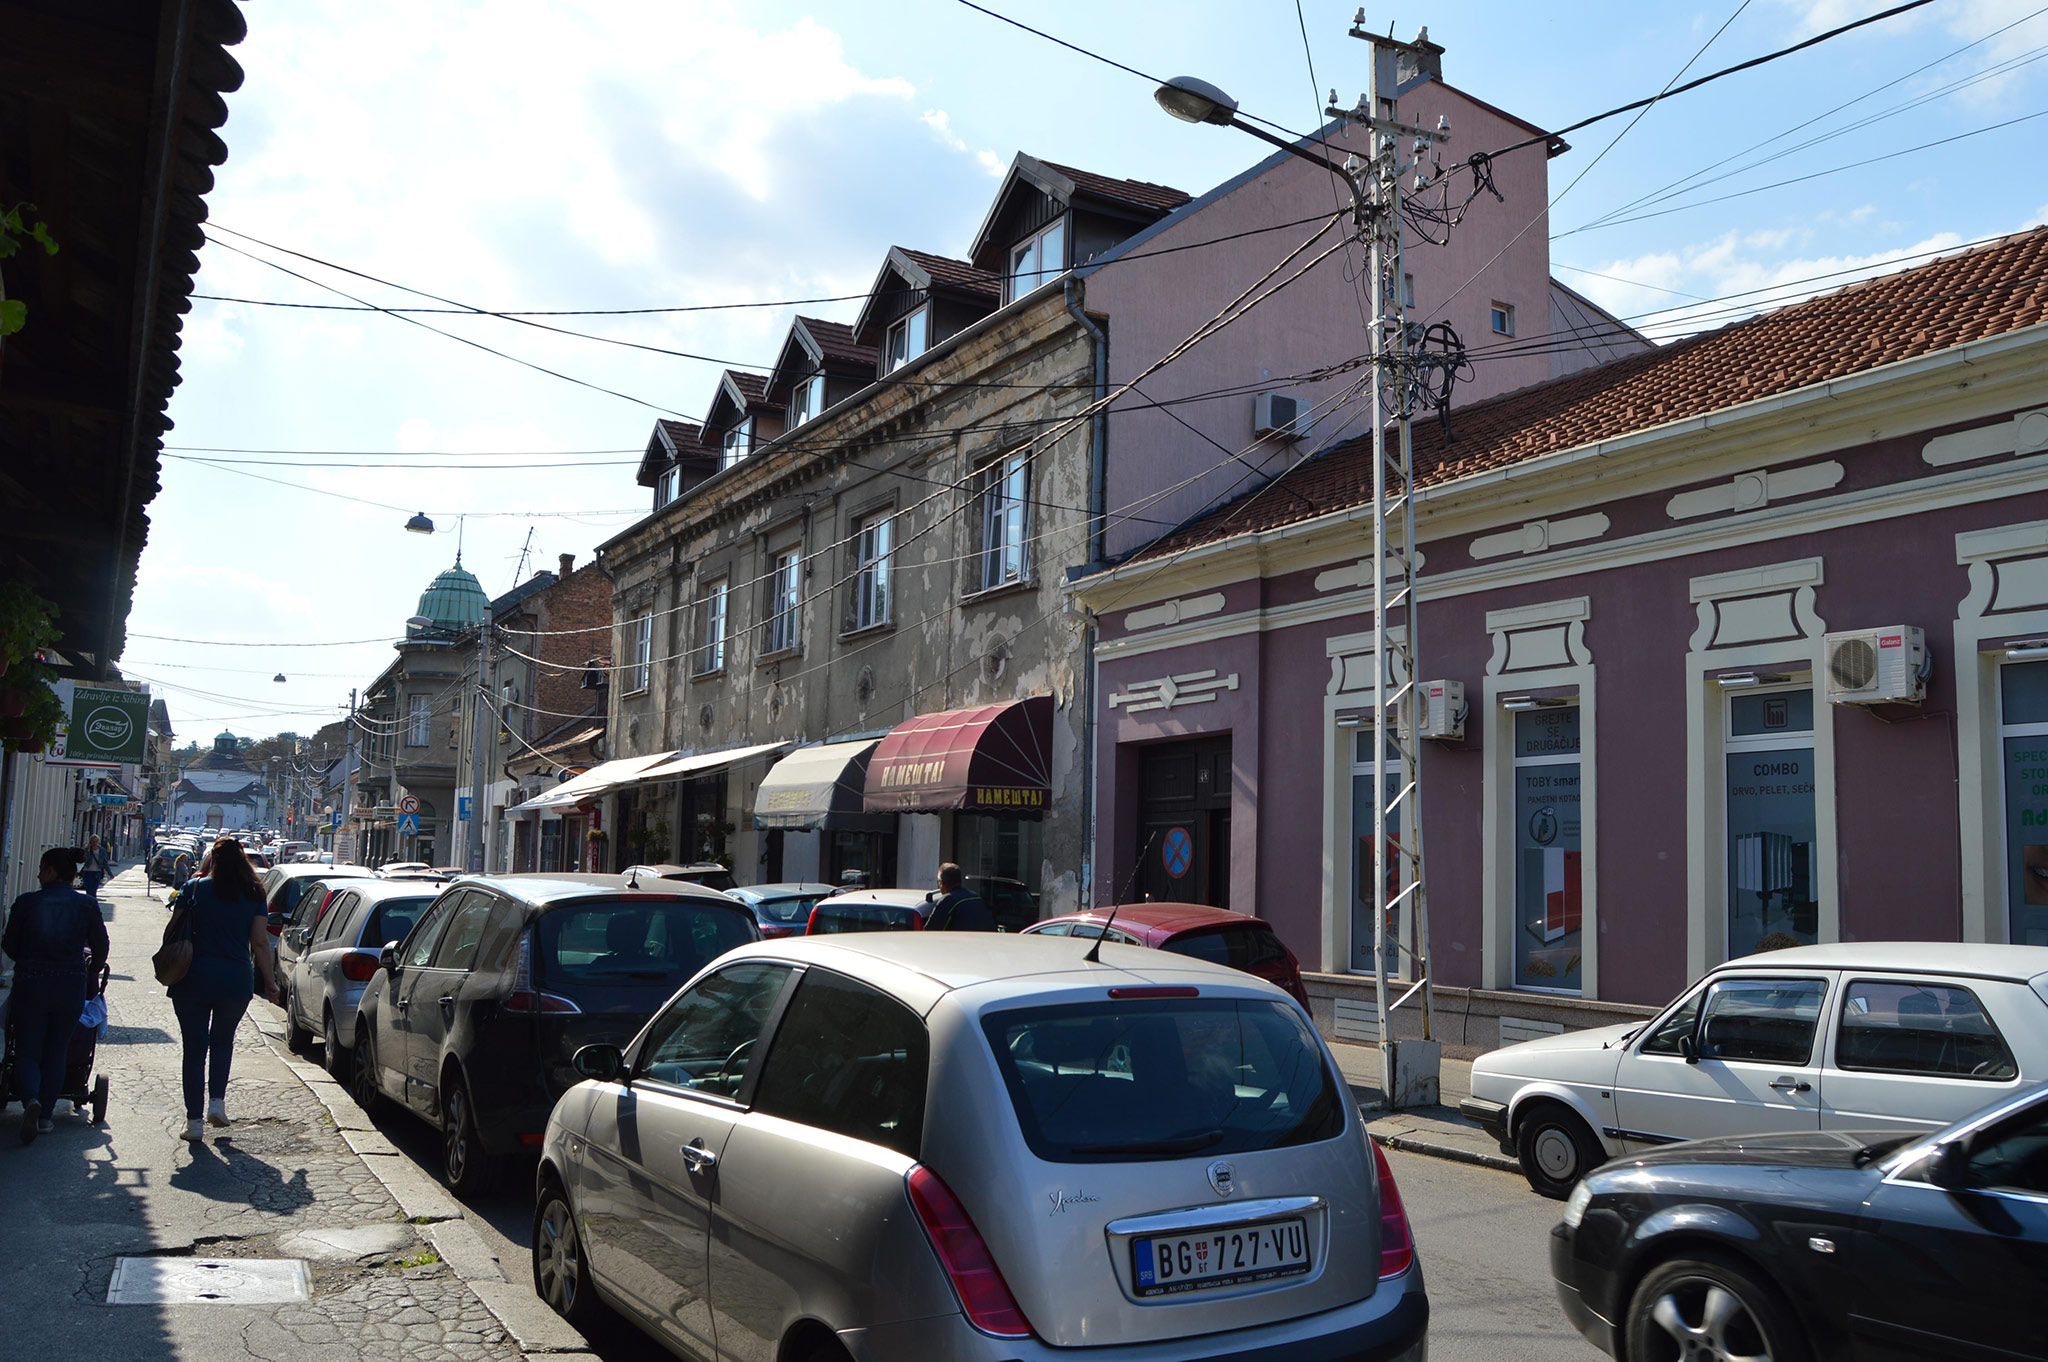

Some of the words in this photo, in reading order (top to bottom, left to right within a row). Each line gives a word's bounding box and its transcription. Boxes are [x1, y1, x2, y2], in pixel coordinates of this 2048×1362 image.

[75, 689, 111, 703] Zdravlje
[112, 693, 120, 702] iz
[121, 694, 147, 705] Sibira
[1534, 712, 1573, 726] GREJTE
[95, 722, 122, 732] Эвалар
[1547, 726, 1559, 738] SE
[1526, 738, 1581, 752] DRUGAČIJE
[86, 752, 112, 760] prirodni
[881, 761, 946, 787] НАМЕШТАЈ
[1754, 762, 1799, 776] COMBO
[1526, 776, 1552, 788] TOBY
[977, 788, 1043, 806] НАМЕШТАЈ
[1732, 786, 1758, 796] DRVO,
[1760, 785, 1790, 795] PELET,
[1527, 796, 1558, 804] PAMETNI
[1158, 1240, 1193, 1279] BG
[1140, 1270, 1153, 1281] SRB
